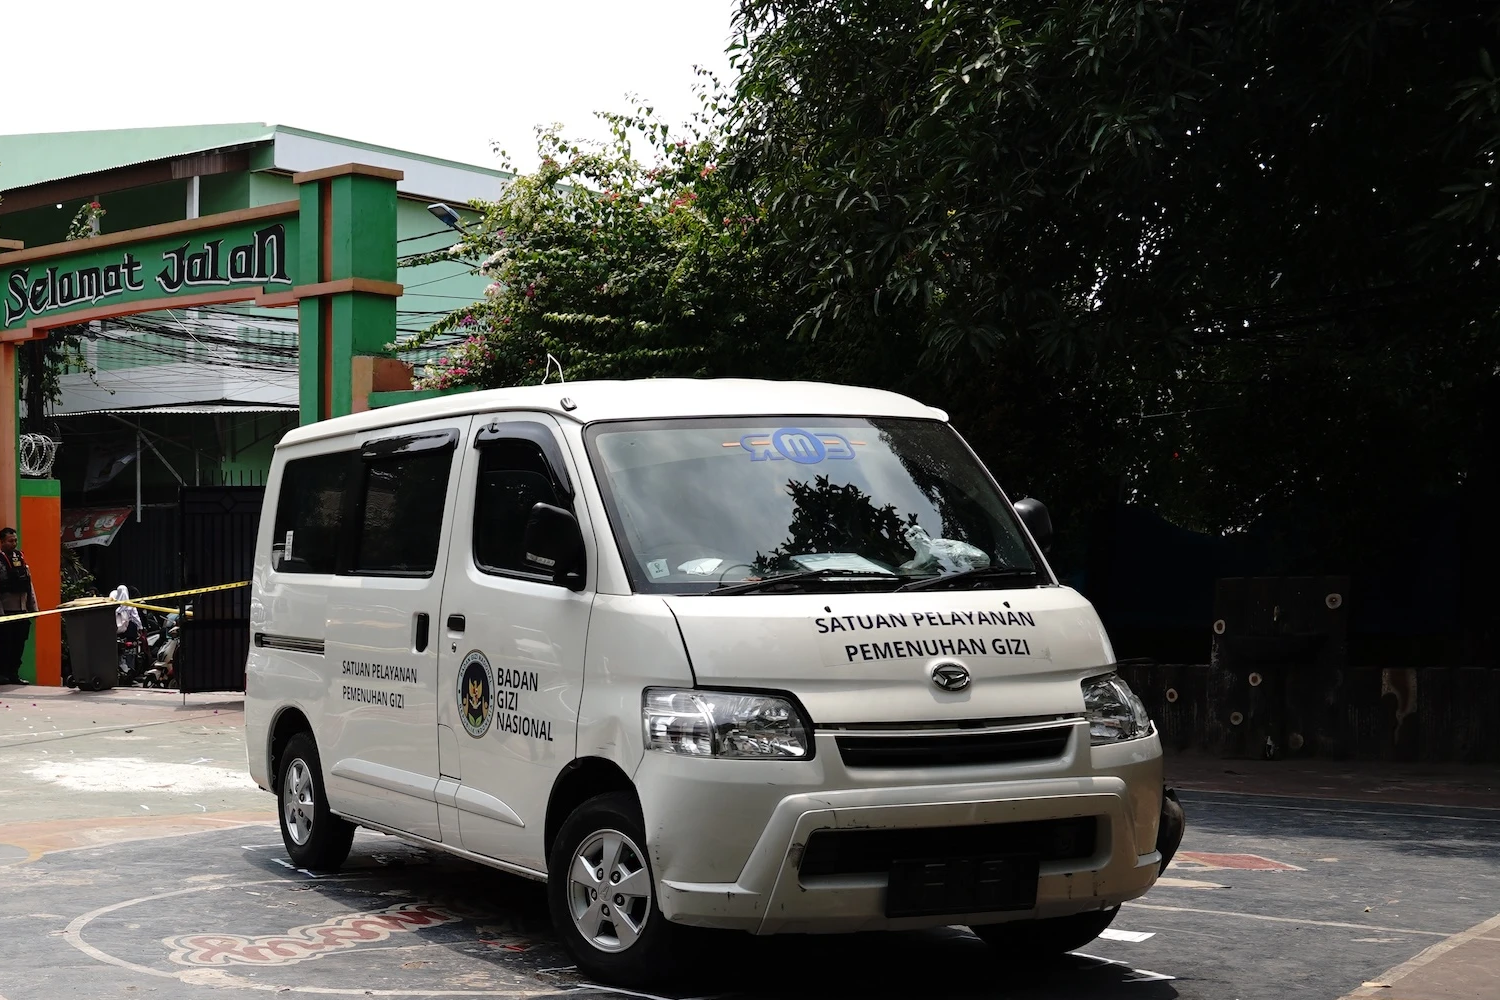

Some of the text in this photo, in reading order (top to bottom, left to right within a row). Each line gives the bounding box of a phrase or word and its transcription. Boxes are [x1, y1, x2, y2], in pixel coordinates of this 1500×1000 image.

[4, 223, 292, 328] Selamat Jalan
[814, 611, 1036, 634] SATUAN PELAYANAN
[844, 638, 1031, 662] PEMENUHAN GIZI
[342, 660, 418, 683] SATUAN PELAYANAN
[497, 667, 539, 692] BADAN
[342, 685, 405, 709] PEMENUHAN GIZI
[496, 689, 519, 711] GIZI
[496, 711, 554, 742] NASIONAL
